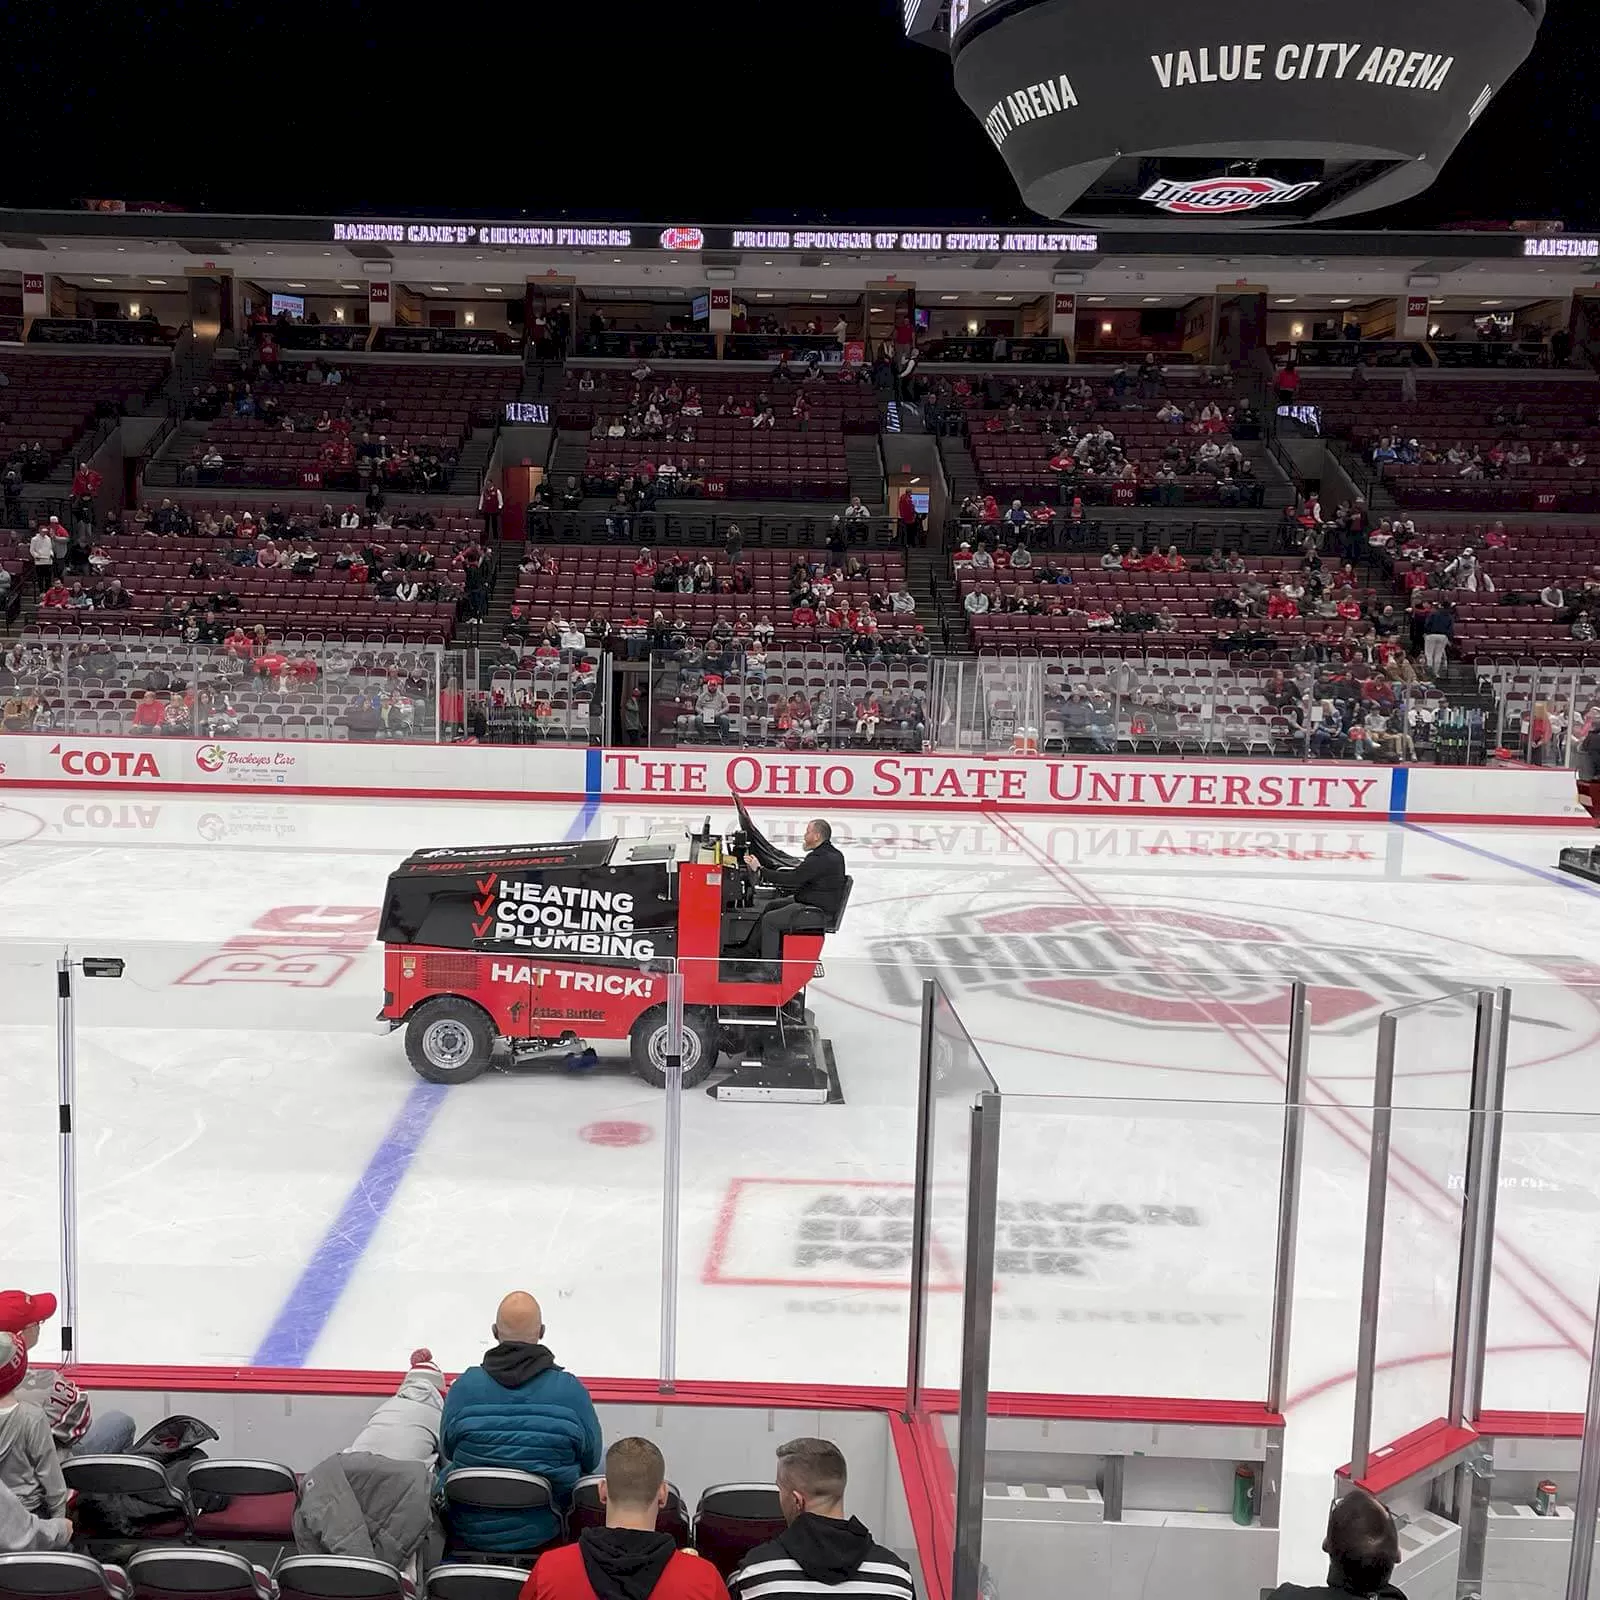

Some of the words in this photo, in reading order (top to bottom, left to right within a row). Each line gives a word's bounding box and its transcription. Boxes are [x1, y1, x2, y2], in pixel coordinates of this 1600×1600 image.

[1150, 44, 1266, 88] VALUE
[1275, 43, 1361, 81] CITY
[1355, 46, 1454, 91] ARENA
[985, 101, 1013, 145] CITY
[1006, 74, 1080, 126] ARENA
[333, 223, 404, 241] RAISING
[479, 227, 553, 245] CHICKEN
[556, 228, 632, 246] FINGERS
[733, 231, 790, 248] PROUD
[793, 232, 872, 249] SPONSOR
[875, 233, 899, 249] OF
[902, 233, 942, 250] OHIO
[946, 234, 1000, 250] STATE
[1002, 234, 1098, 251] ATHLETICS
[26, 280, 42, 288] 203
[371, 288, 388, 297] 204
[712, 295, 729, 304] 205
[1057, 300, 1074, 308] 206
[1409, 303, 1425, 311] 207
[303, 473, 320, 482] 104
[708, 483, 724, 492] 105
[1116, 488, 1134, 498] 106
[1538, 494, 1556, 503] 107
[61, 750, 161, 778] COTA
[227, 751, 271, 767] Buckeyes
[273, 751, 296, 766] Care
[499, 880, 634, 914] HEATING
[496, 901, 635, 938] COOLING
[494, 922, 655, 962] PLUMBING
[491, 962, 552, 987] HAT
[554, 969, 653, 999] TRICK!
[532, 1007, 564, 1019] Atlas
[566, 1008, 606, 1020] Butler
[793, 1244, 1088, 1276] POER
[50, 1381, 78, 1409] 13
